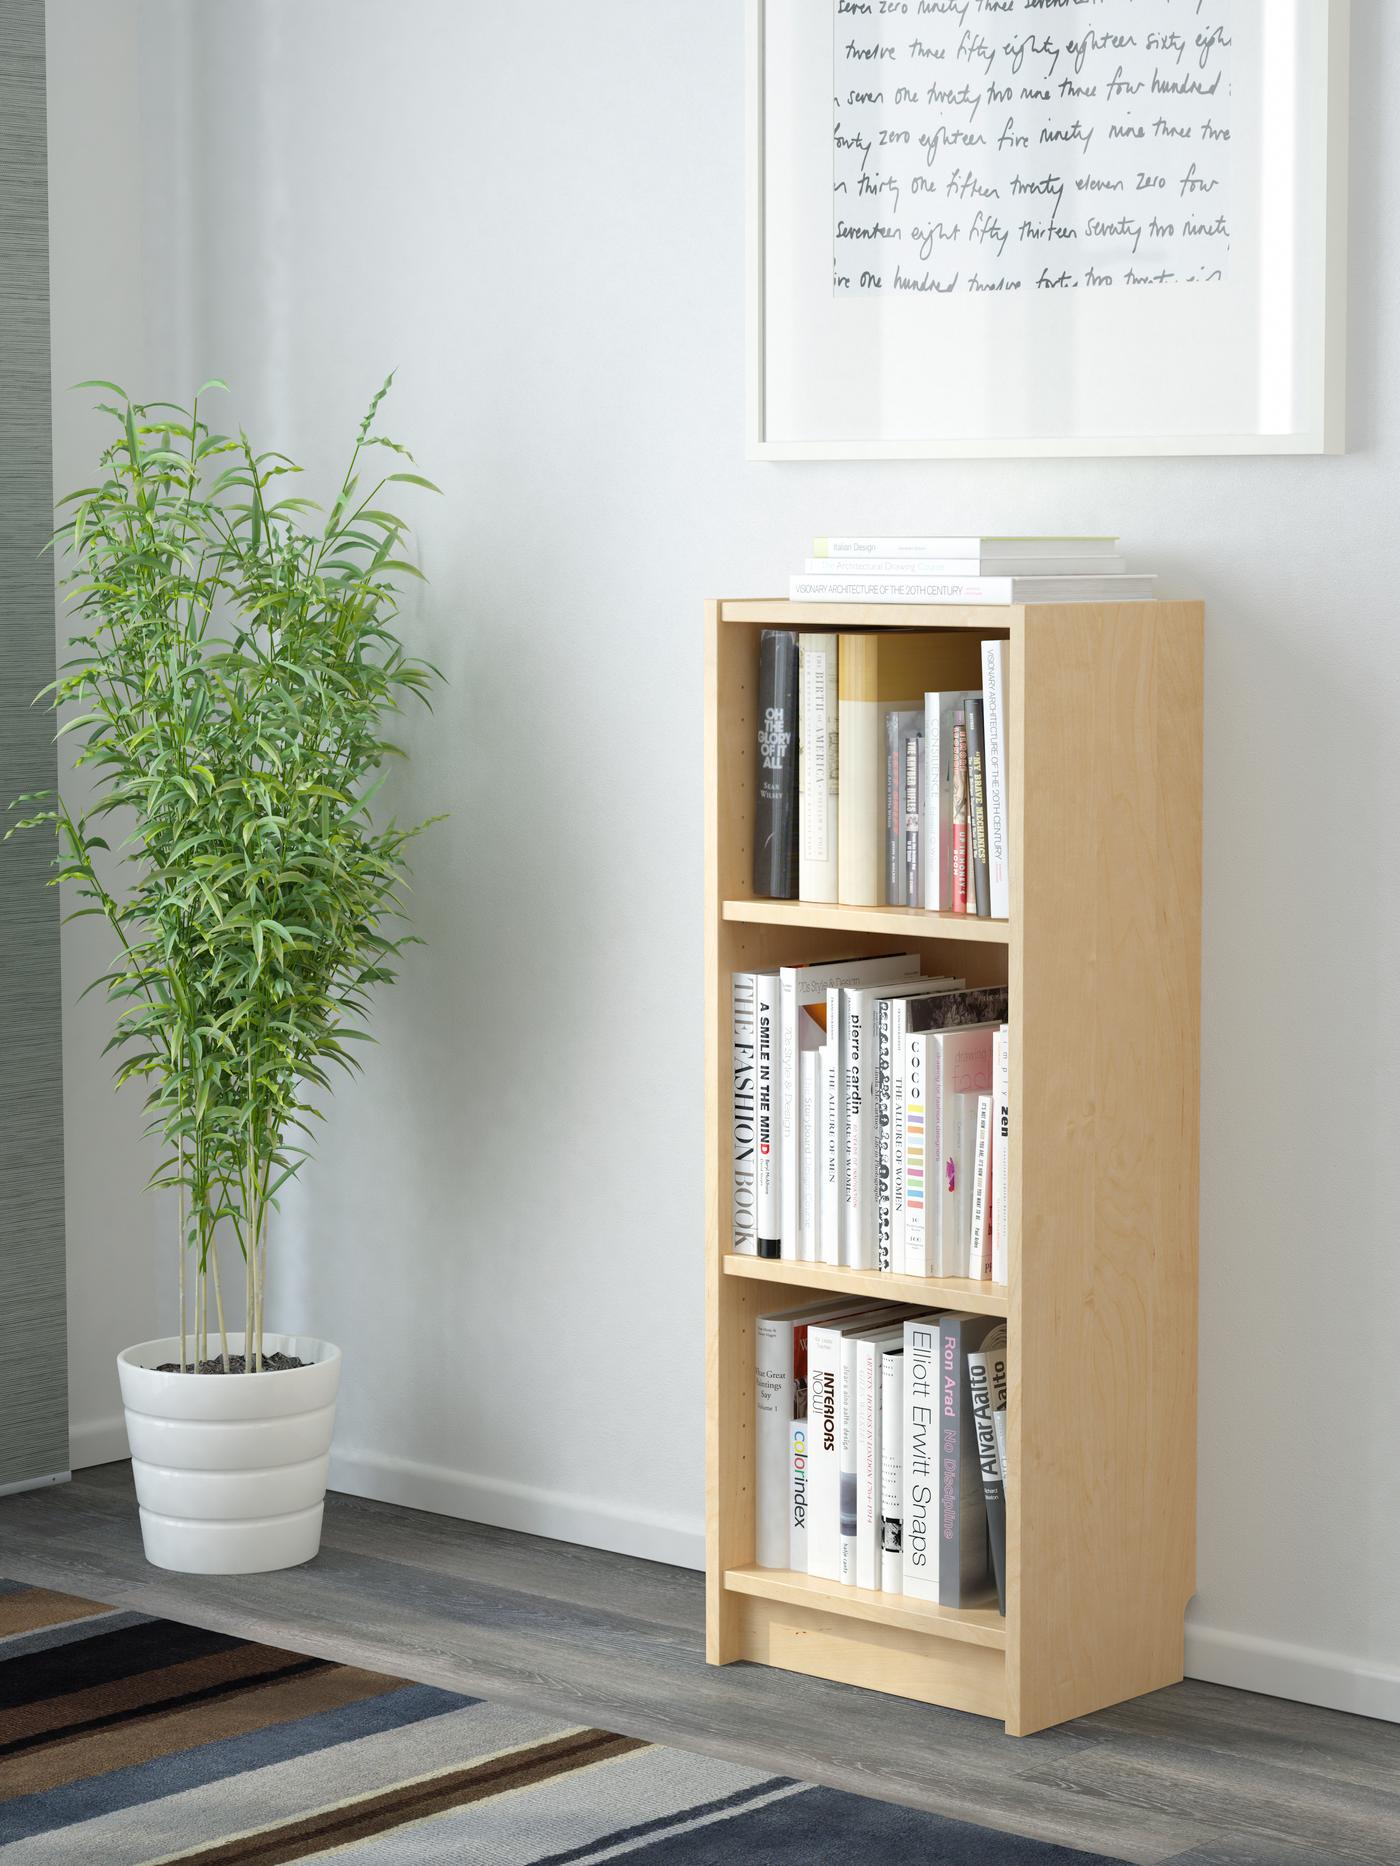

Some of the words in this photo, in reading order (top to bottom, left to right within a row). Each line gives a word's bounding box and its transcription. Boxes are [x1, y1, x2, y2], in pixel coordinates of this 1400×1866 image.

[880, 0, 908, 14] zero
[845, 39, 896, 60] twelve
[909, 38, 945, 59] three
[957, 29, 996, 75] fifty
[1003, 34, 1060, 77] eighty
[1066, 23, 1137, 75] eighteen
[1146, 31, 1186, 65] sixty
[847, 90, 884, 105] seven
[895, 87, 919, 104] one
[927, 81, 981, 123] twenty
[987, 81, 1013, 104] two
[1020, 76, 1051, 100] nine
[1058, 77, 1097, 98] three
[1107, 65, 1145, 101] four
[1151, 67, 1222, 95] hundred
[879, 130, 910, 145] zero
[918, 111, 986, 167] eighteen
[997, 116, 1029, 151] five
[1040, 117, 1094, 154] ninety
[1108, 111, 1145, 139] nine
[1152, 117, 1191, 138] three
[858, 172, 899, 213] thirty
[911, 176, 936, 194] one
[946, 168, 999, 199] fifteen
[1010, 173, 1064, 219] twenty
[1075, 174, 1124, 191] eleven
[1136, 172, 1166, 190] zero
[1180, 162, 1219, 197] four
[836, 221, 901, 240] seventeen
[911, 221, 960, 261] eight
[969, 210, 1008, 257] fifty
[1018, 220, 1077, 241] thirteen
[1085, 216, 1141, 254] seventy
[1149, 216, 1175, 237] two
[860, 271, 882, 288] one
[893, 265, 958, 292] hundred
[1085, 267, 1112, 286] two
[854, 543, 877, 554] Design
[795, 584, 827, 594] VISIONARY
[828, 584, 878, 595] ARCHITECTURE
[879, 585, 890, 595] OF
[891, 585, 904, 595] THE
[906, 585, 926, 596] 20TH
[927, 585, 962, 596] CENTURY
[987, 649, 996, 690] VISIONARY
[815, 672, 824, 711] BIRTH
[764, 720, 784, 732] THE
[765, 708, 784, 720] OH
[989, 692, 998, 755] ARCHITECTURE
[758, 731, 791, 745] GLORY
[761, 745, 775, 757] OF
[776, 745, 788, 757] IT
[815, 727, 824, 784] AMERICA
[763, 757, 783, 769] ALL
[991, 757, 998, 769] OF
[975, 774, 983, 804] BRAVE
[992, 790, 1001, 814] 20TH
[960, 832, 965, 843] UP
[960, 846, 965, 855] IN
[994, 815, 1003, 860] CENTURY
[734, 978, 755, 1034] THE
[760, 1002, 769, 1012] A
[760, 1017, 769, 1060] SMILE
[850, 1014, 862, 1060] pierre
[760, 1065, 769, 1080] IN
[783, 1048, 793, 1078] Style
[911, 1041, 920, 1099] COCO
[734, 1041, 755, 1164] FASHION
[760, 1085, 769, 1110] THE
[851, 1066, 862, 1114] cardin
[760, 1115, 769, 1154] MIND
[783, 1093, 793, 1138] Design
[803, 1098, 813, 1153] Storyboard
[1001, 1105, 1009, 1137] zen
[829, 1140, 836, 1154] OF
[896, 1150, 903, 1163] OF
[734, 1170, 755, 1248] BOOK
[912, 1331, 932, 1398] Elliott
[944, 1336, 956, 1370] Ron
[766, 1370, 786, 1379] Great
[812, 1370, 823, 1414] NOW!
[760, 1390, 771, 1400] Say
[823, 1372, 834, 1451] INTERIORS
[944, 1376, 956, 1416] Arad
[841, 1427, 850, 1451] design
[912, 1405, 931, 1477] Erwitt
[944, 1429, 957, 1452] No
[794, 1431, 808, 1529] colorindex
[942, 1458, 957, 1540] Discipline
[909, 1483, 932, 1566] Snaps
